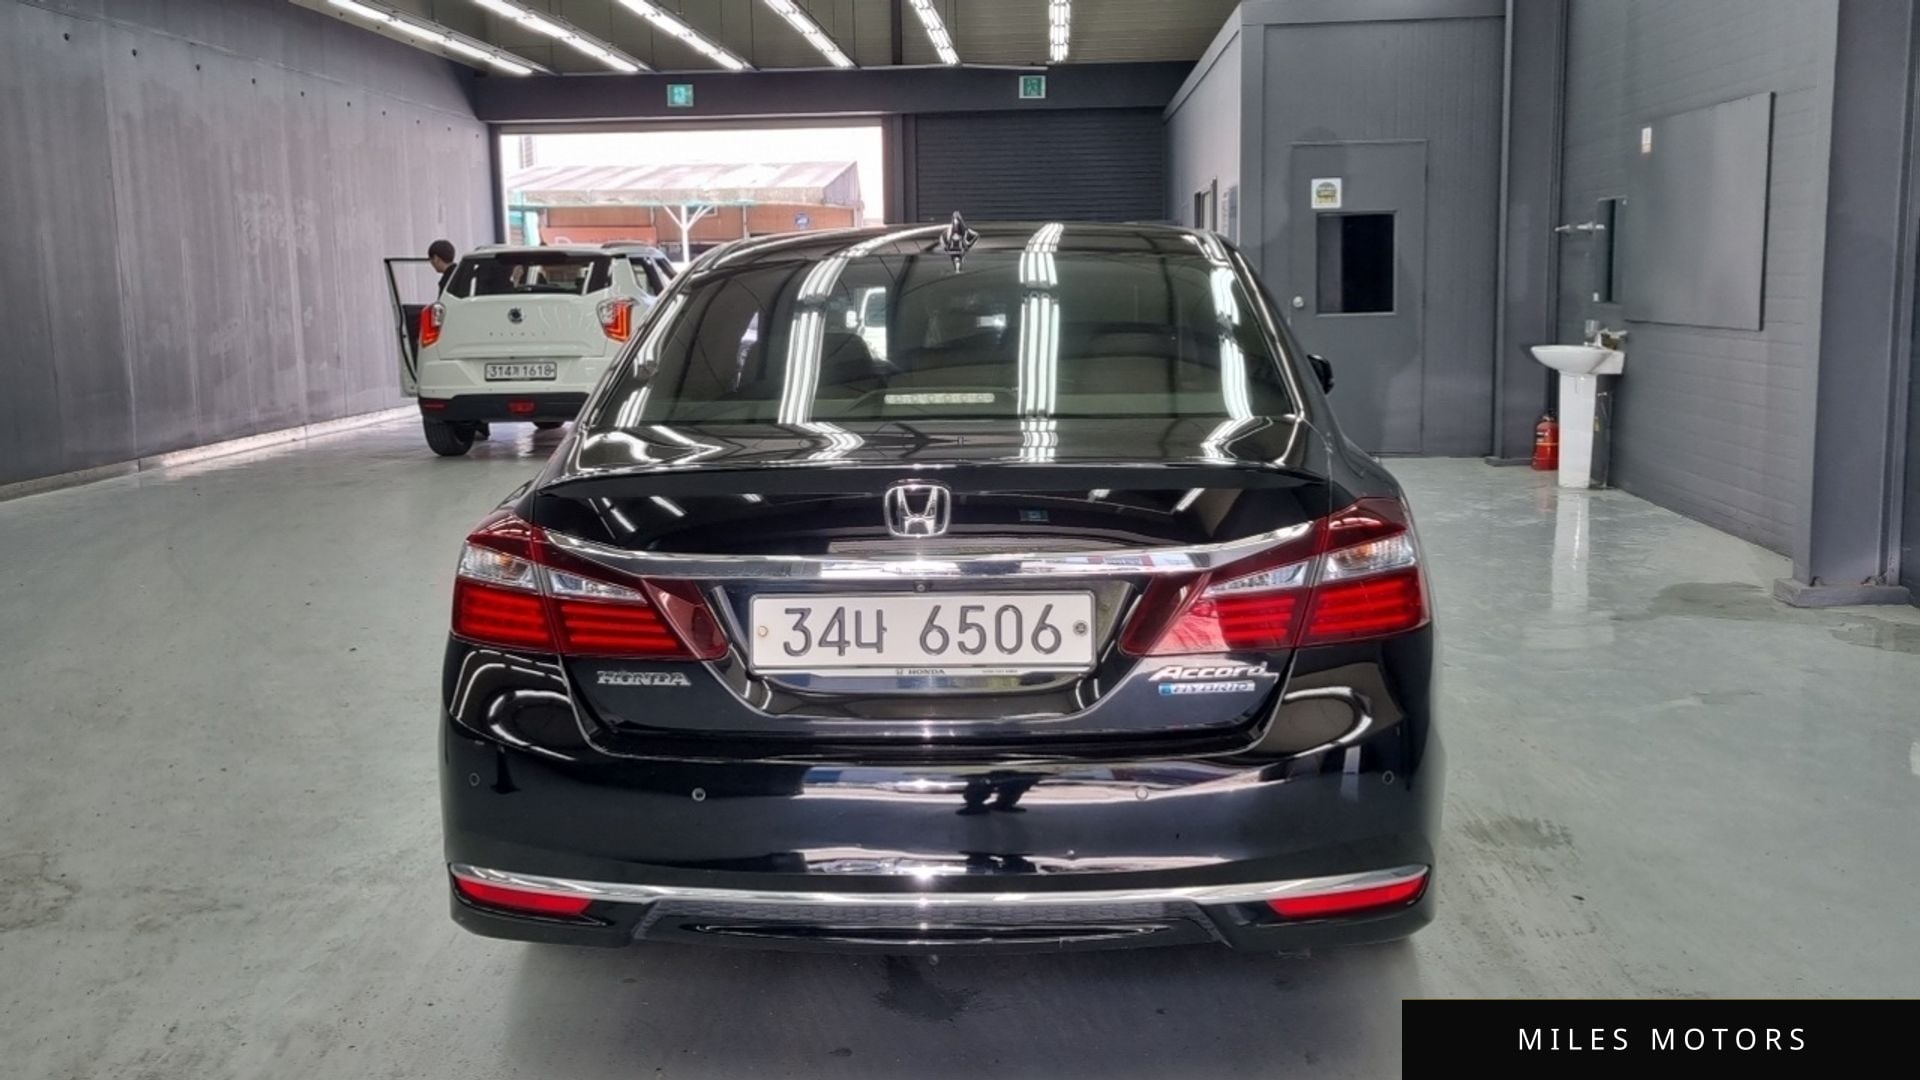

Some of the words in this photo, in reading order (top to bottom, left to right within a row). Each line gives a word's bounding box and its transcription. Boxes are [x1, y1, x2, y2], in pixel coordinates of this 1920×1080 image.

[783, 606, 887, 657] 34나
[919, 604, 1062, 655] 6506
[597, 671, 691, 685] HONDA
[1148, 661, 1279, 683] Accord
